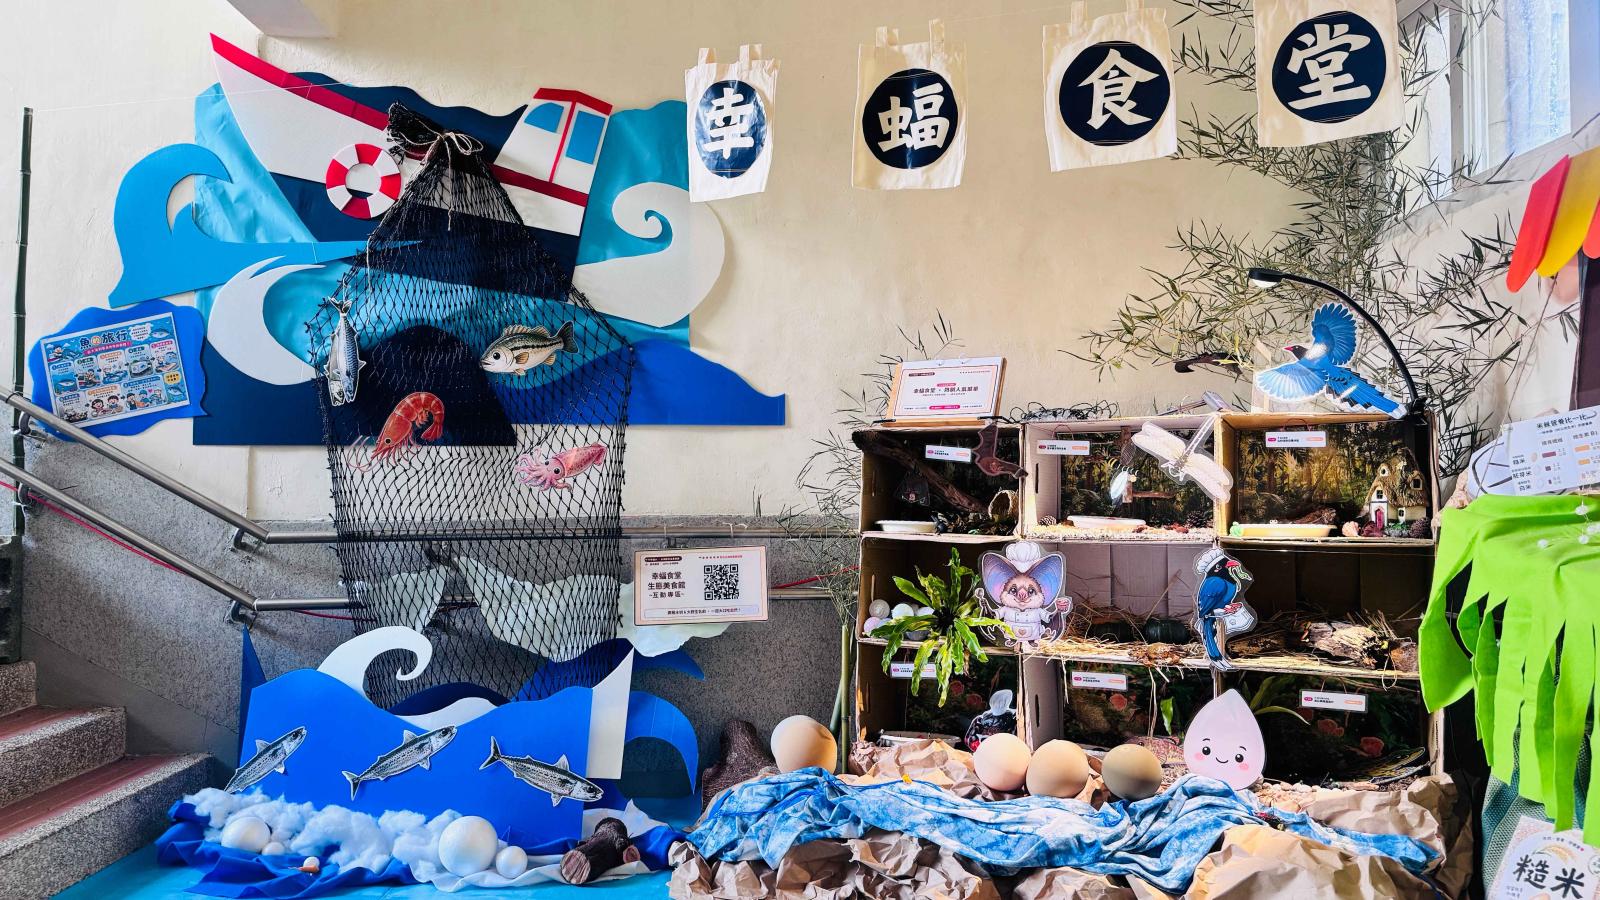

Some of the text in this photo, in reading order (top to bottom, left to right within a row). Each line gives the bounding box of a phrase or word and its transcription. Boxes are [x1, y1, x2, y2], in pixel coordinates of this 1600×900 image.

[1076, 48, 1160, 130] 食
[1286, 23, 1372, 110] 堂
[703, 87, 755, 160] 幸
[877, 82, 950, 153] 蝠
[80, 329, 128, 350] 魚的旅行
[1512, 854, 1585, 900] 糙米
